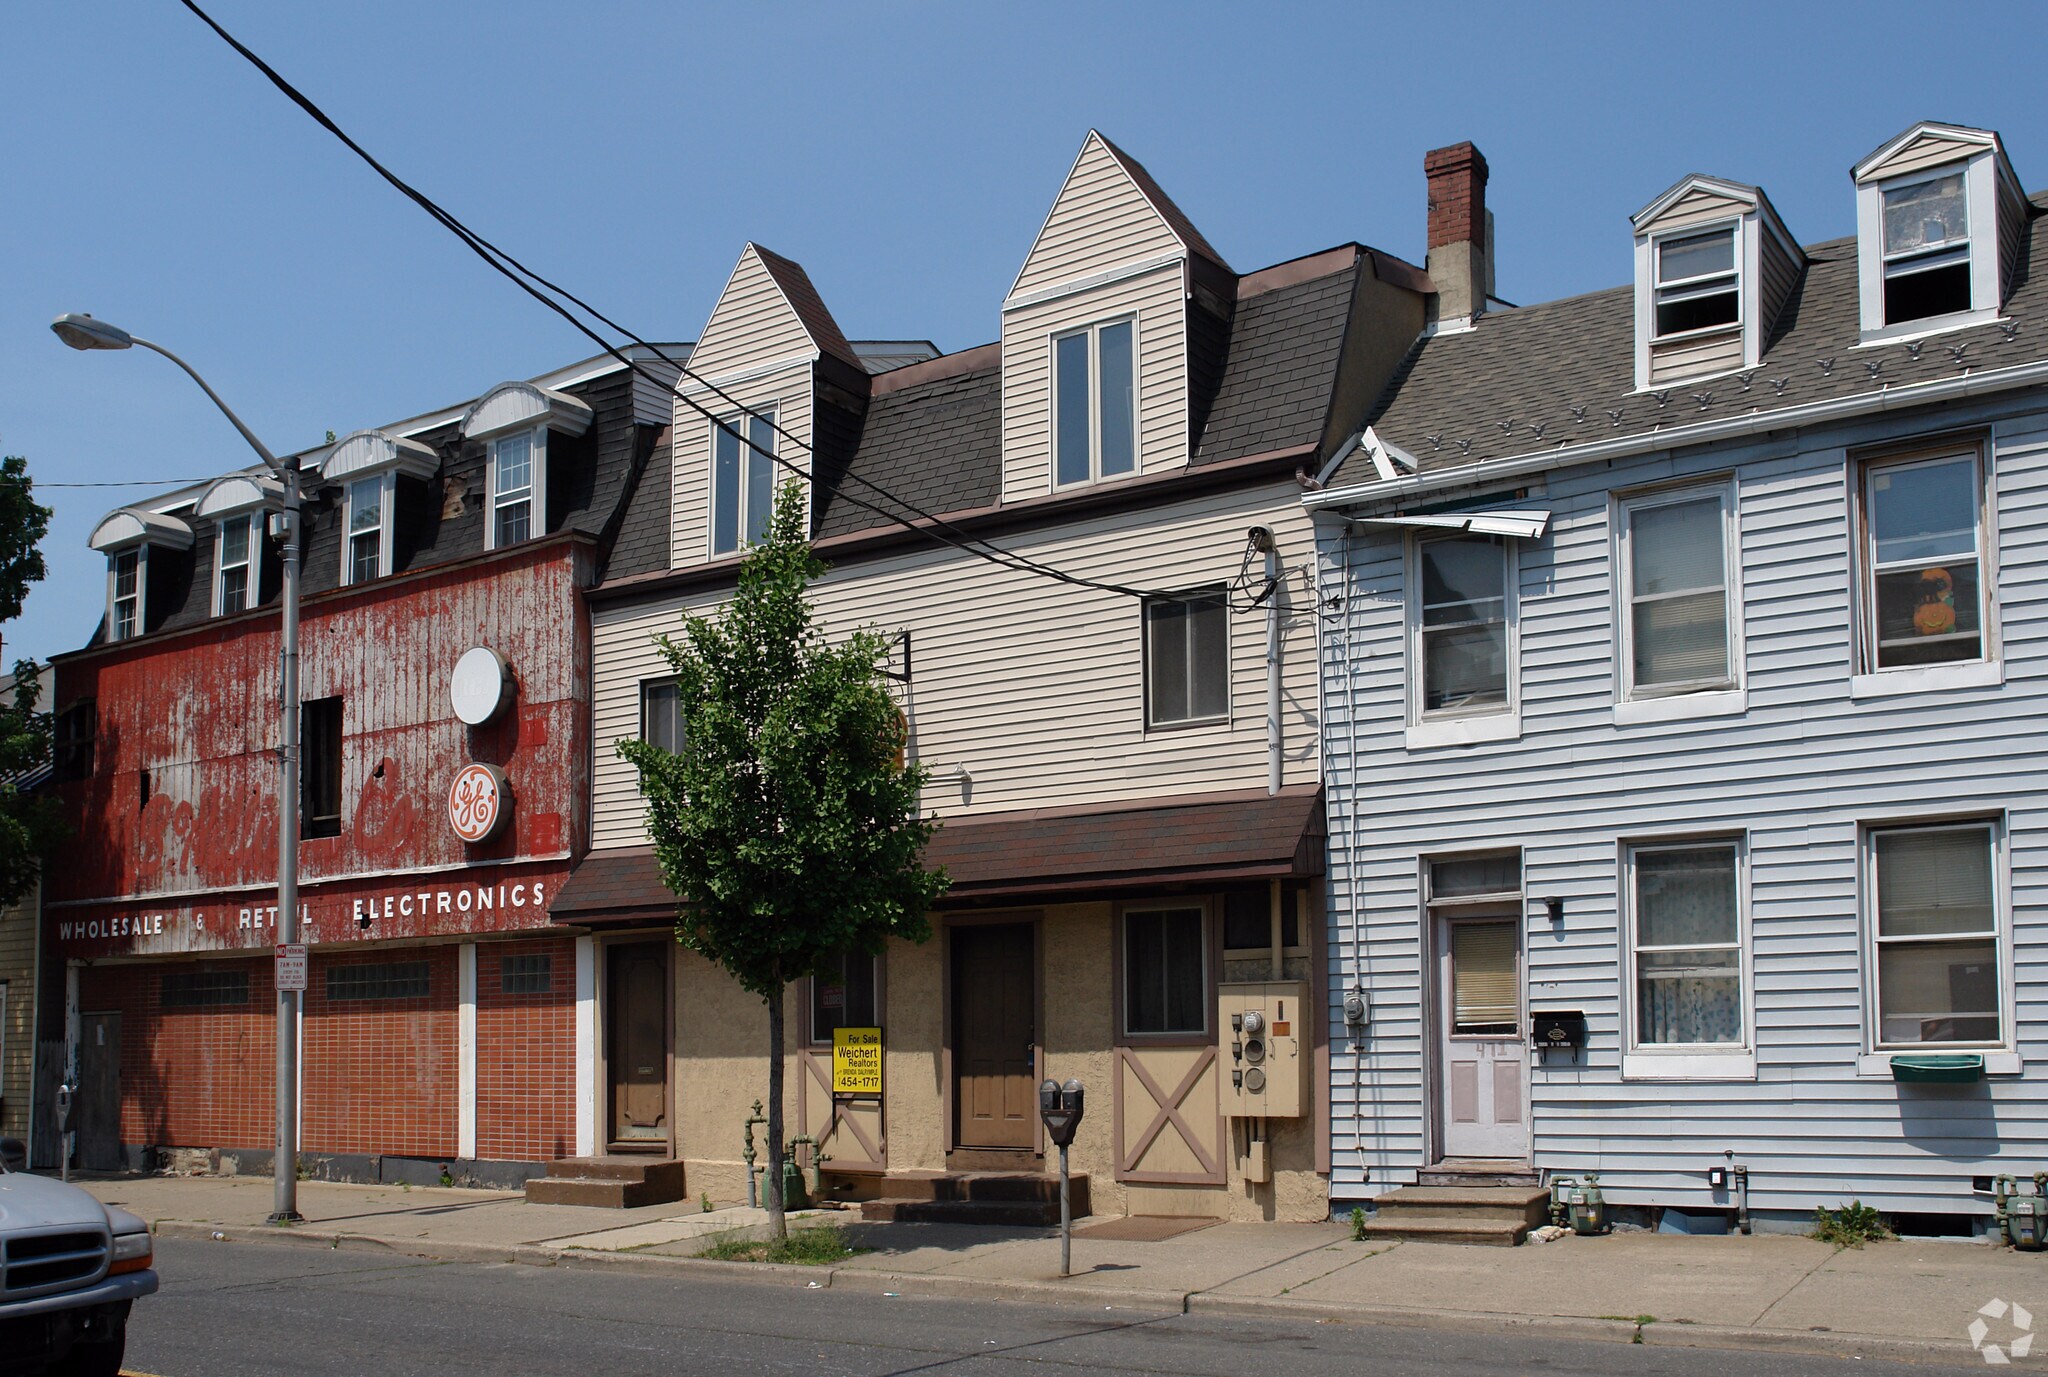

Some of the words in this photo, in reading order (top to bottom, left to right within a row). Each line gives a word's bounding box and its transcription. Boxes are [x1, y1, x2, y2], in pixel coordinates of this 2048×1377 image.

[60, 915, 163, 940] WHOLESALE
[196, 913, 204, 931] &
[239, 903, 313, 929] RETL
[353, 883, 544, 921] ELECTRONICS
[848, 1034, 860, 1044] For
[862, 1034, 878, 1044] Sale
[838, 1046, 878, 1058] Weichert
[848, 1058, 878, 1067] Realtors
[841, 1076, 879, 1087] 454-1717
